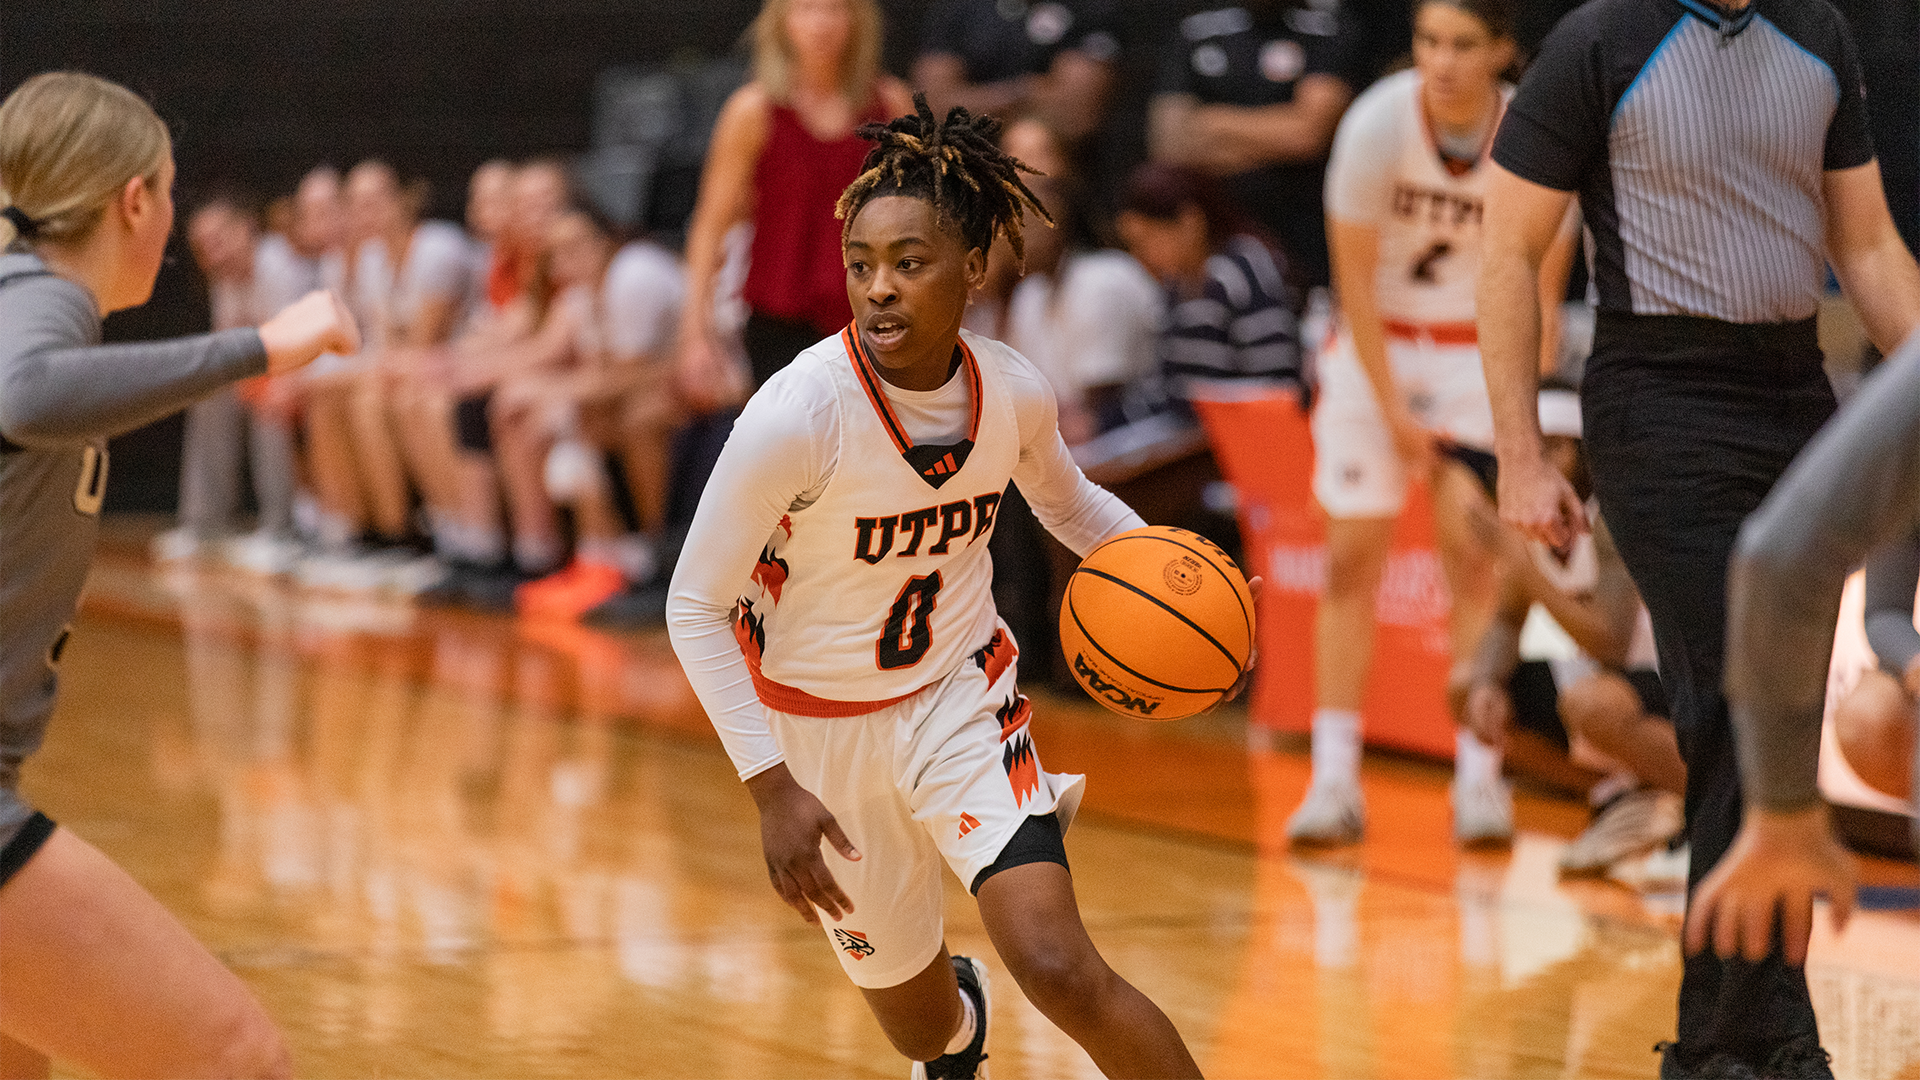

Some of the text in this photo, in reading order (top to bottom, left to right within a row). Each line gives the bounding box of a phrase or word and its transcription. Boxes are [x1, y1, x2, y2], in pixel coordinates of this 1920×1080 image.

[875, 569, 944, 671] 0
[1074, 652, 1161, 714] NCAA
[1100, 668, 1122, 686] GAME
